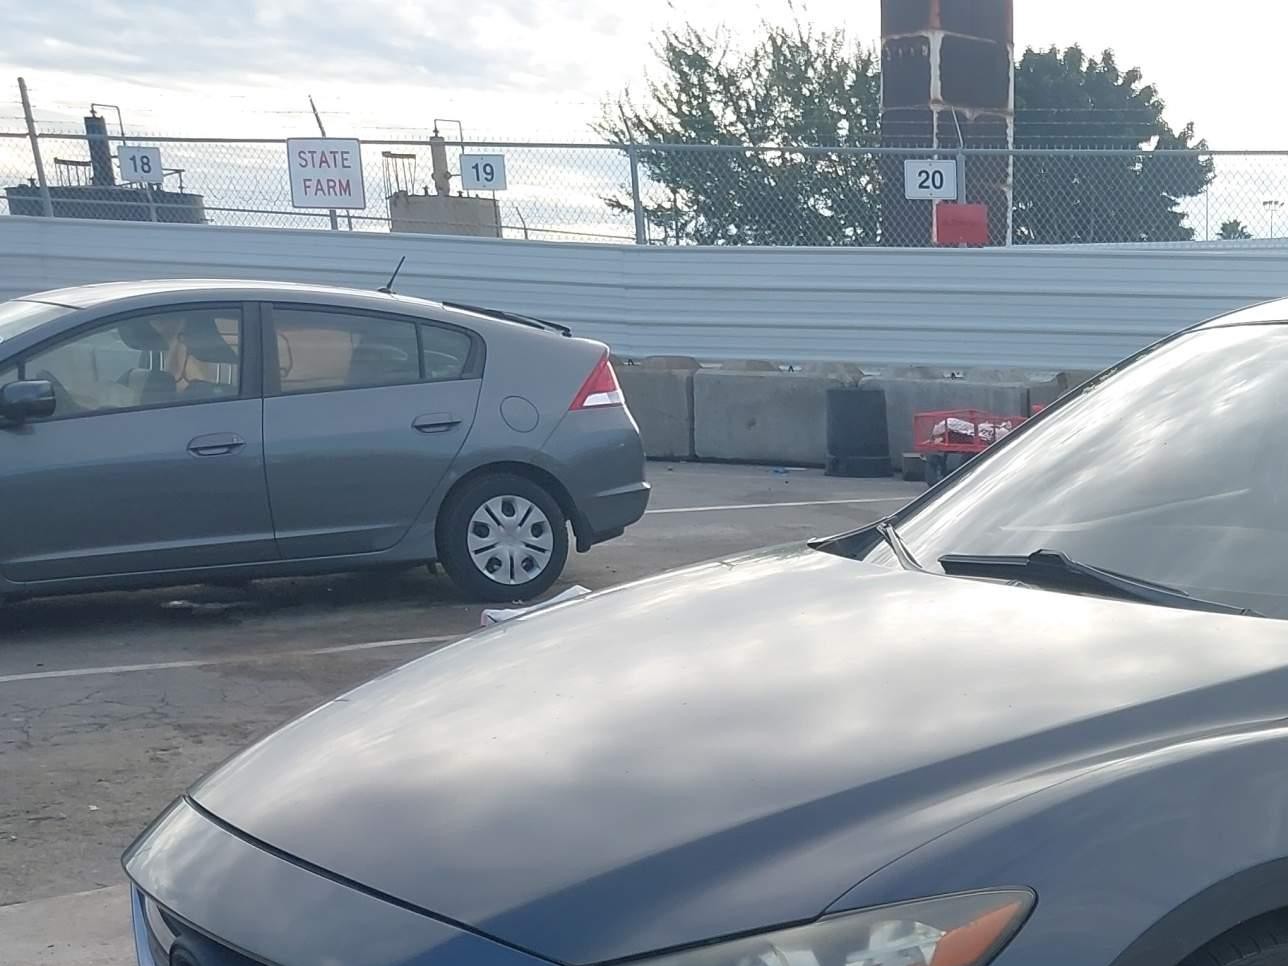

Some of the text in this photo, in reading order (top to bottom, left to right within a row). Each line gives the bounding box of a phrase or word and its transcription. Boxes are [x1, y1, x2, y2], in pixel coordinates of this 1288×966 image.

[129, 154, 152, 174] 18
[298, 150, 351, 169] STATE
[472, 162, 495, 182] 19
[917, 169, 944, 190] 20
[303, 178, 351, 197] FARM
